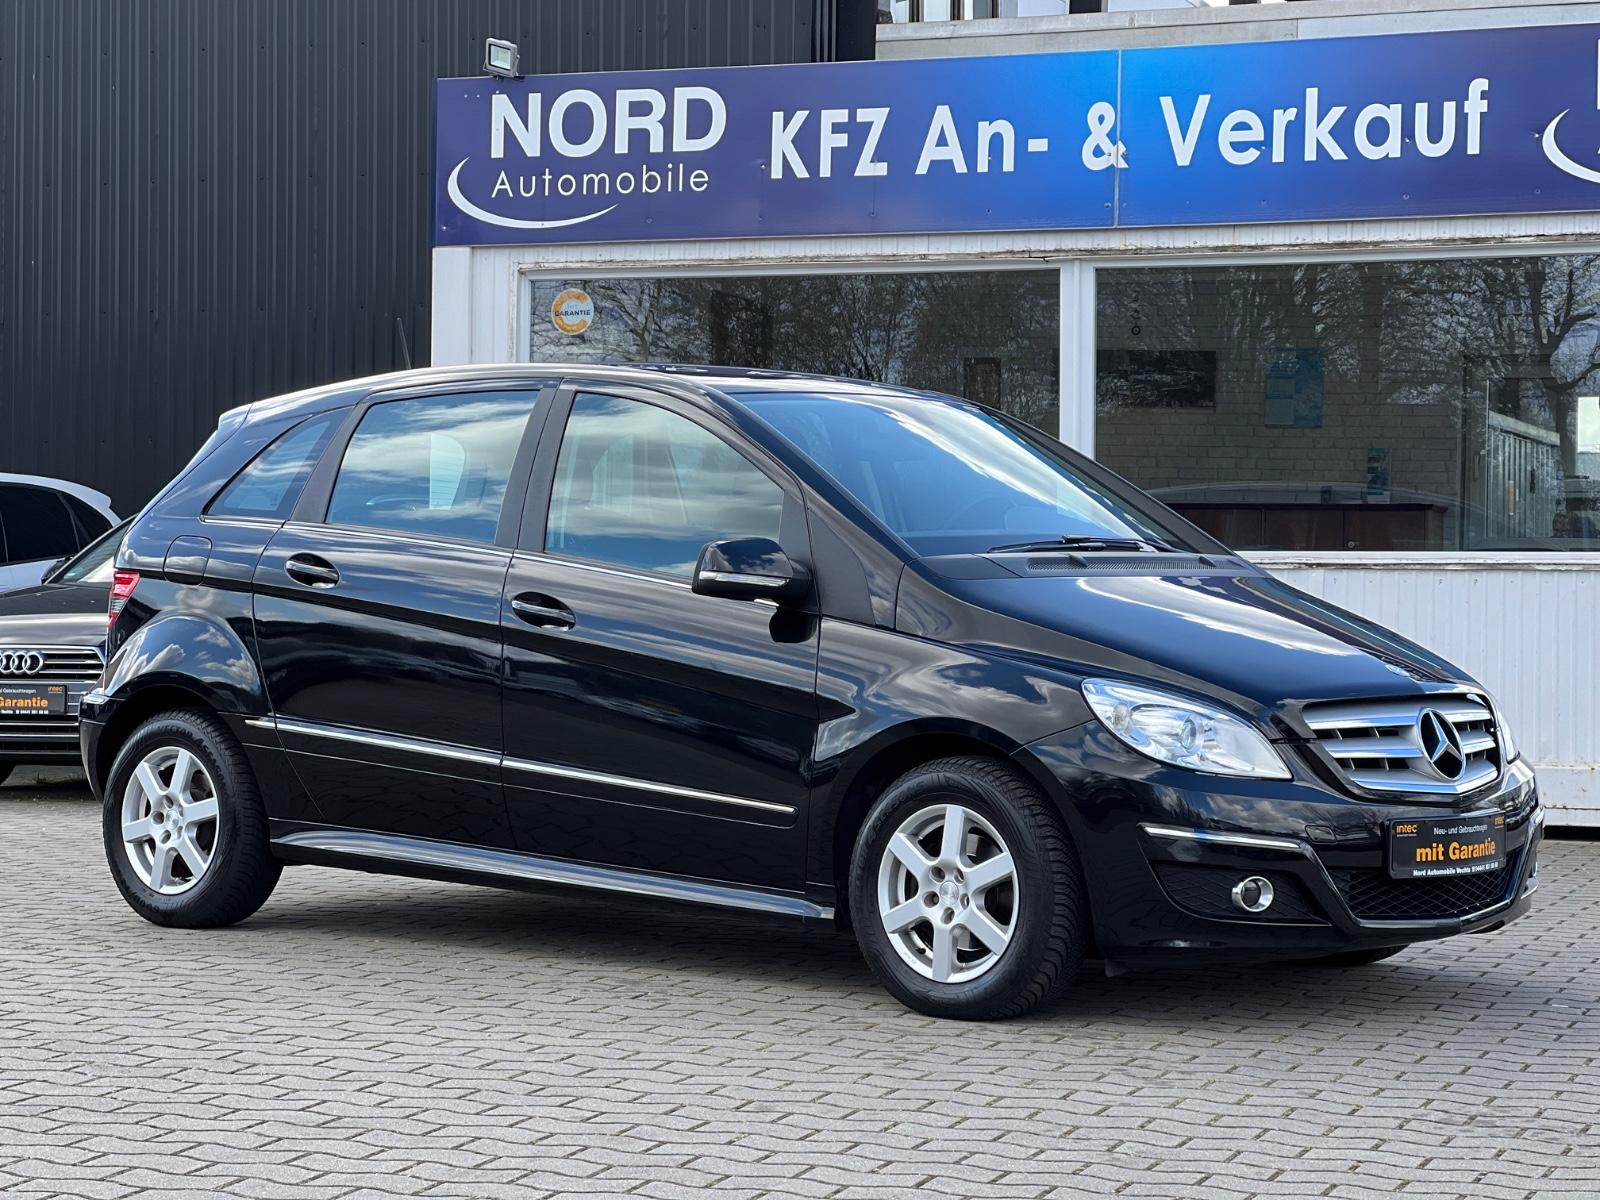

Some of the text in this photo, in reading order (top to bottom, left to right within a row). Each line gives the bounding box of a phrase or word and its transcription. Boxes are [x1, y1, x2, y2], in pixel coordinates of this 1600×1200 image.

[490, 86, 728, 160] NORD
[770, 78, 1490, 180] KFZ An- & Verkauf
[491, 164, 710, 199] Automobile
[1396, 824, 1418, 833] intec
[1416, 838, 1495, 861] mit Garantie
